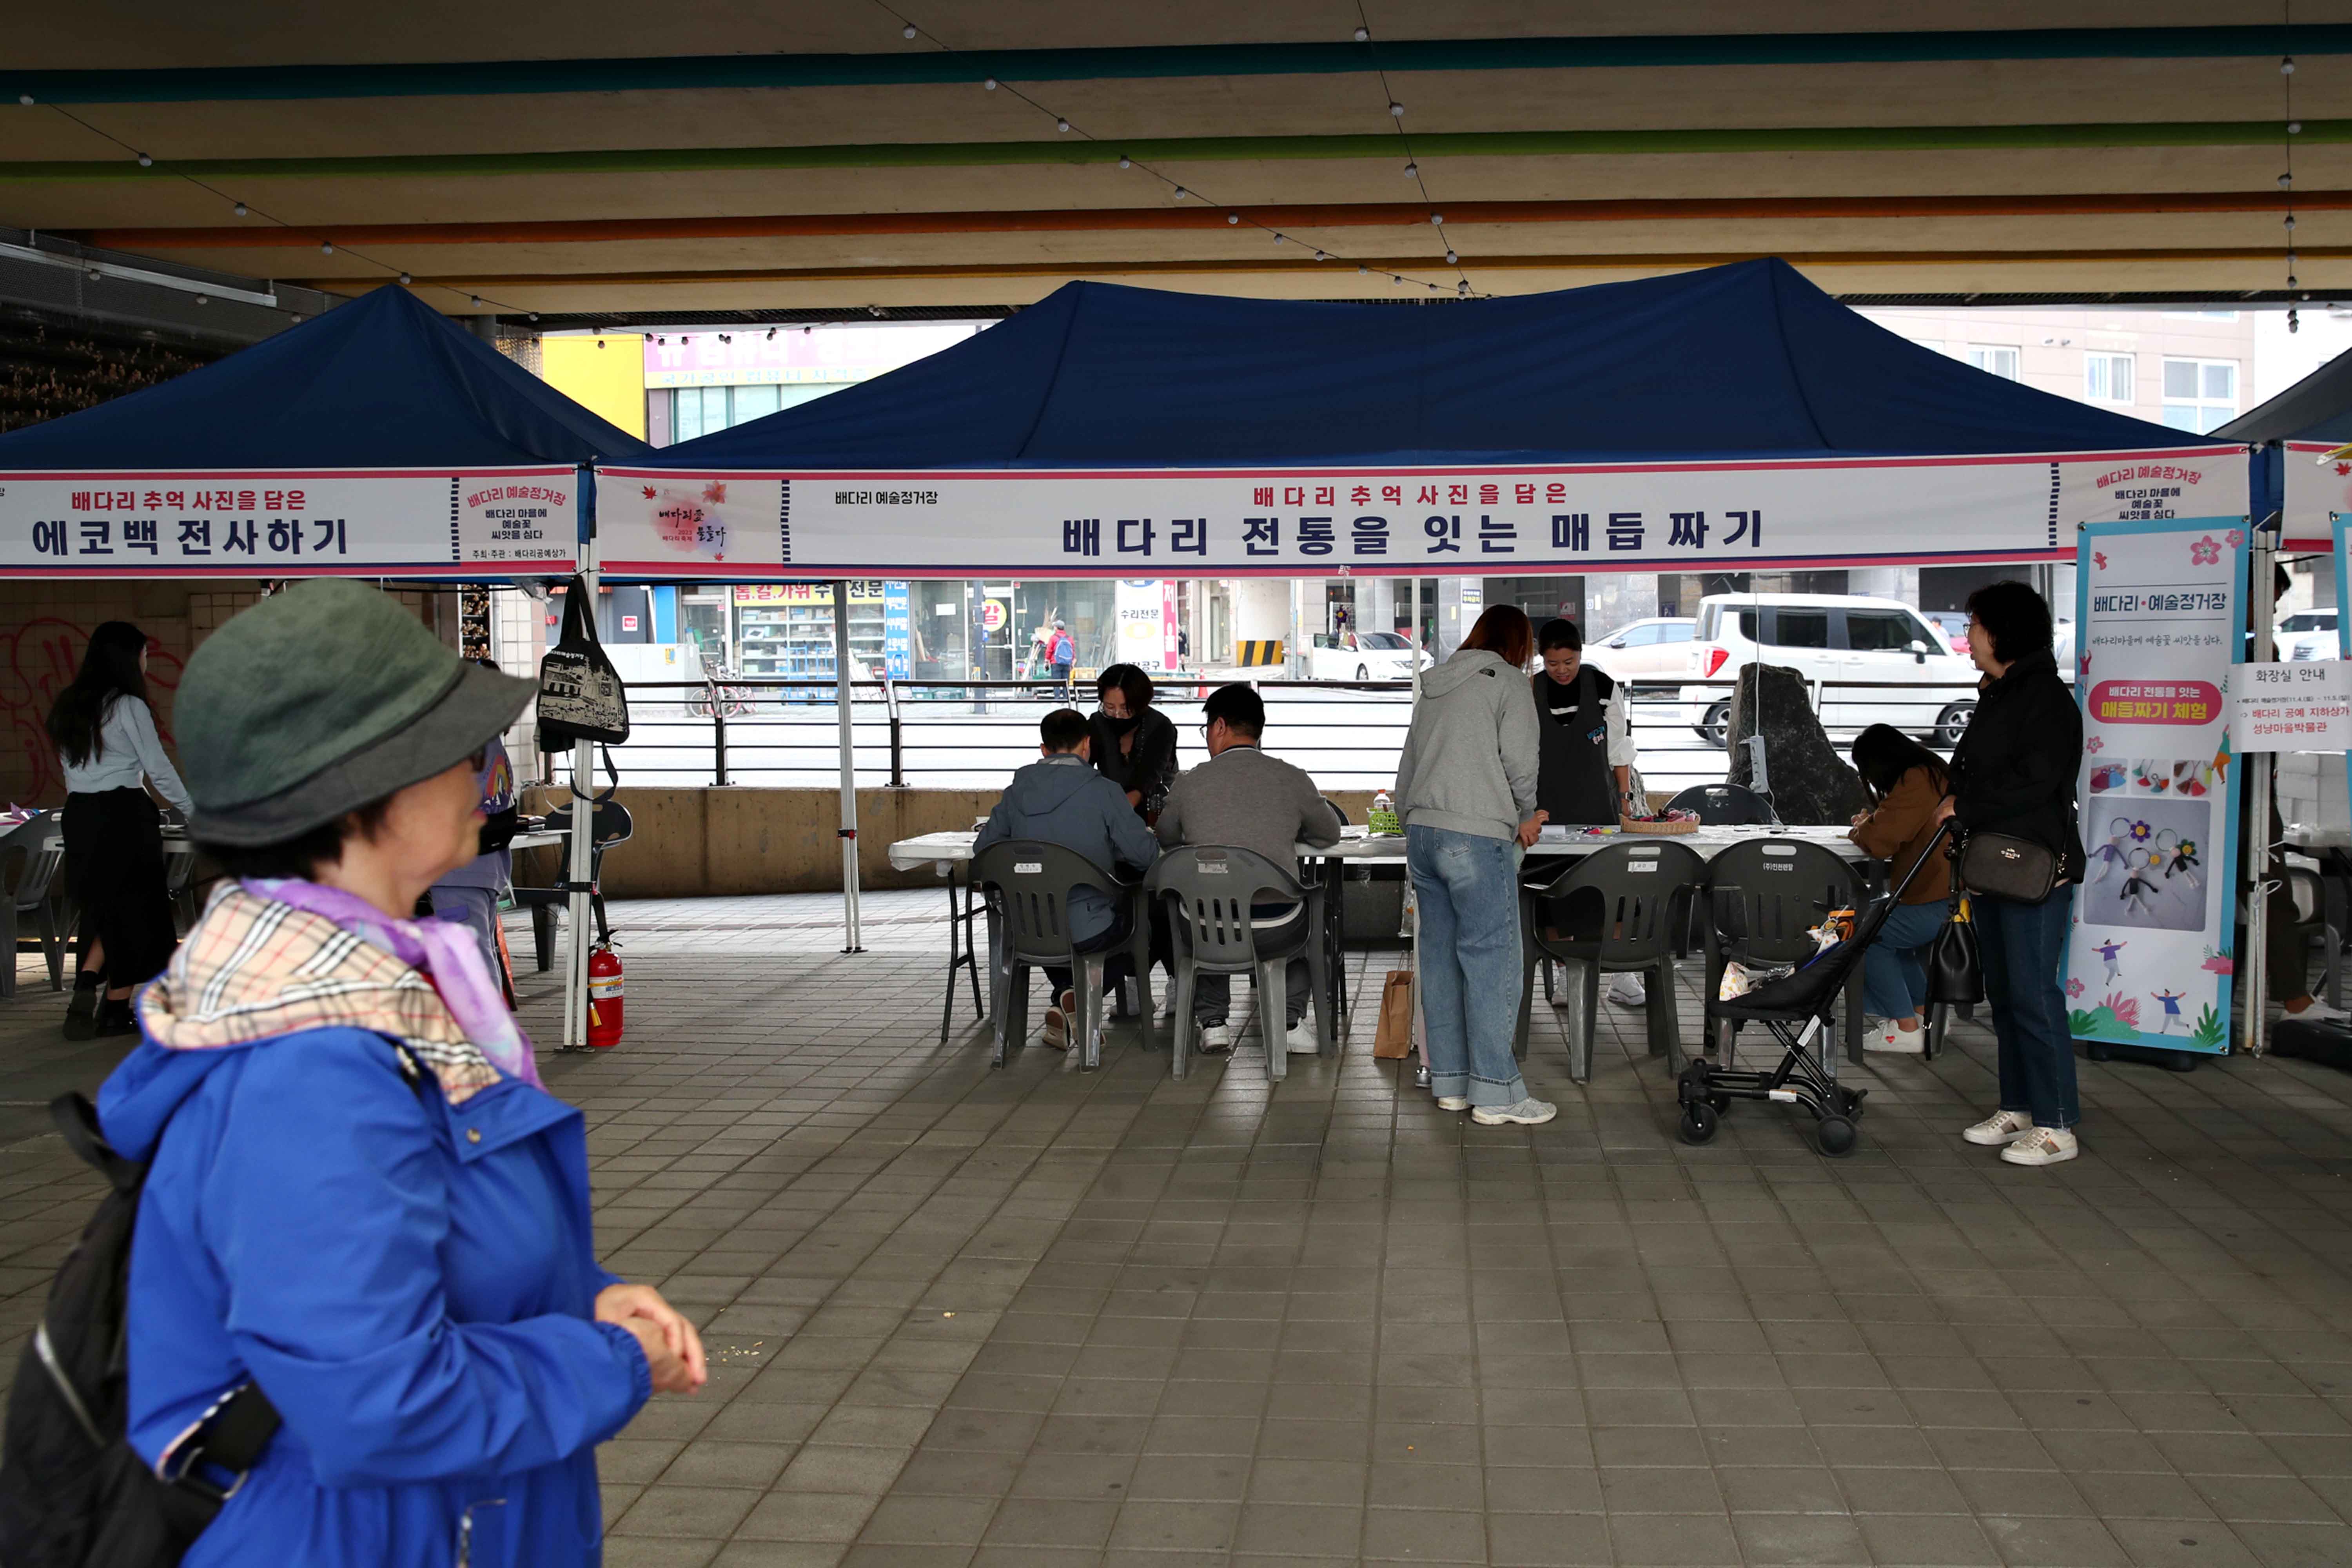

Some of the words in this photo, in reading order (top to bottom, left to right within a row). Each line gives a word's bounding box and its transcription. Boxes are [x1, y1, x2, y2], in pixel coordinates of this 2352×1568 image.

[2097, 468, 2134, 488] 배다리
[2138, 465, 2201, 485] 예술정거장
[467, 488, 503, 508] 배다리
[506, 486, 566, 506] 예술정거장
[835, 492, 872, 504] 배다리
[876, 491, 938, 505] 예술정거장
[1254, 487, 1334, 507] 배다리
[1351, 486, 1401, 506] 추억
[1417, 484, 1499, 505] 사진을
[1515, 483, 1566, 504] 담은
[2115, 489, 2146, 499] 배다리
[2150, 488, 2181, 497] 마을에
[72, 492, 134, 511] 배다리
[143, 491, 184, 511] 추억
[192, 491, 256, 511] 사진을
[265, 490, 306, 510] 담은
[2132, 499, 2163, 509] 예술꽃
[486, 510, 515, 518] 배다리
[518, 509, 547, 517] 마을에
[2119, 510, 2150, 520] 씨앗을
[2154, 509, 2174, 519] 심다
[503, 520, 531, 528] 예술꽃
[32, 520, 158, 556] 에코백
[177, 519, 347, 555] 전사하기
[492, 530, 520, 539] 씨앗을
[524, 530, 543, 539] 심다
[1063, 518, 1207, 556] 배다리
[1242, 516, 1390, 555] 전통을
[1424, 515, 1517, 554] 잇는
[1552, 513, 1645, 551] 매듭
[1668, 510, 1761, 548] 짜기
[473, 550, 505, 558] 주최·주관
[515, 549, 566, 558] 배다리공예상가
[1121, 610, 1158, 619] 수리전문
[2092, 636, 2142, 645] 배다리마을에
[2256, 670, 2291, 682] 화장실
[2299, 668, 2325, 681] 안내
[2109, 686, 2140, 697] 배다리
[2144, 687, 2175, 697] 전통을
[2178, 687, 2200, 698] 잇는
[2102, 701, 2167, 718] 매듭짜기
[2173, 703, 2207, 719] 체험
[2252, 709, 2280, 719] 배다리
[2285, 708, 2305, 718] 공예
[2310, 706, 2350, 717] 지하상가
[2253, 722, 2327, 735] 성냥마을박물관
